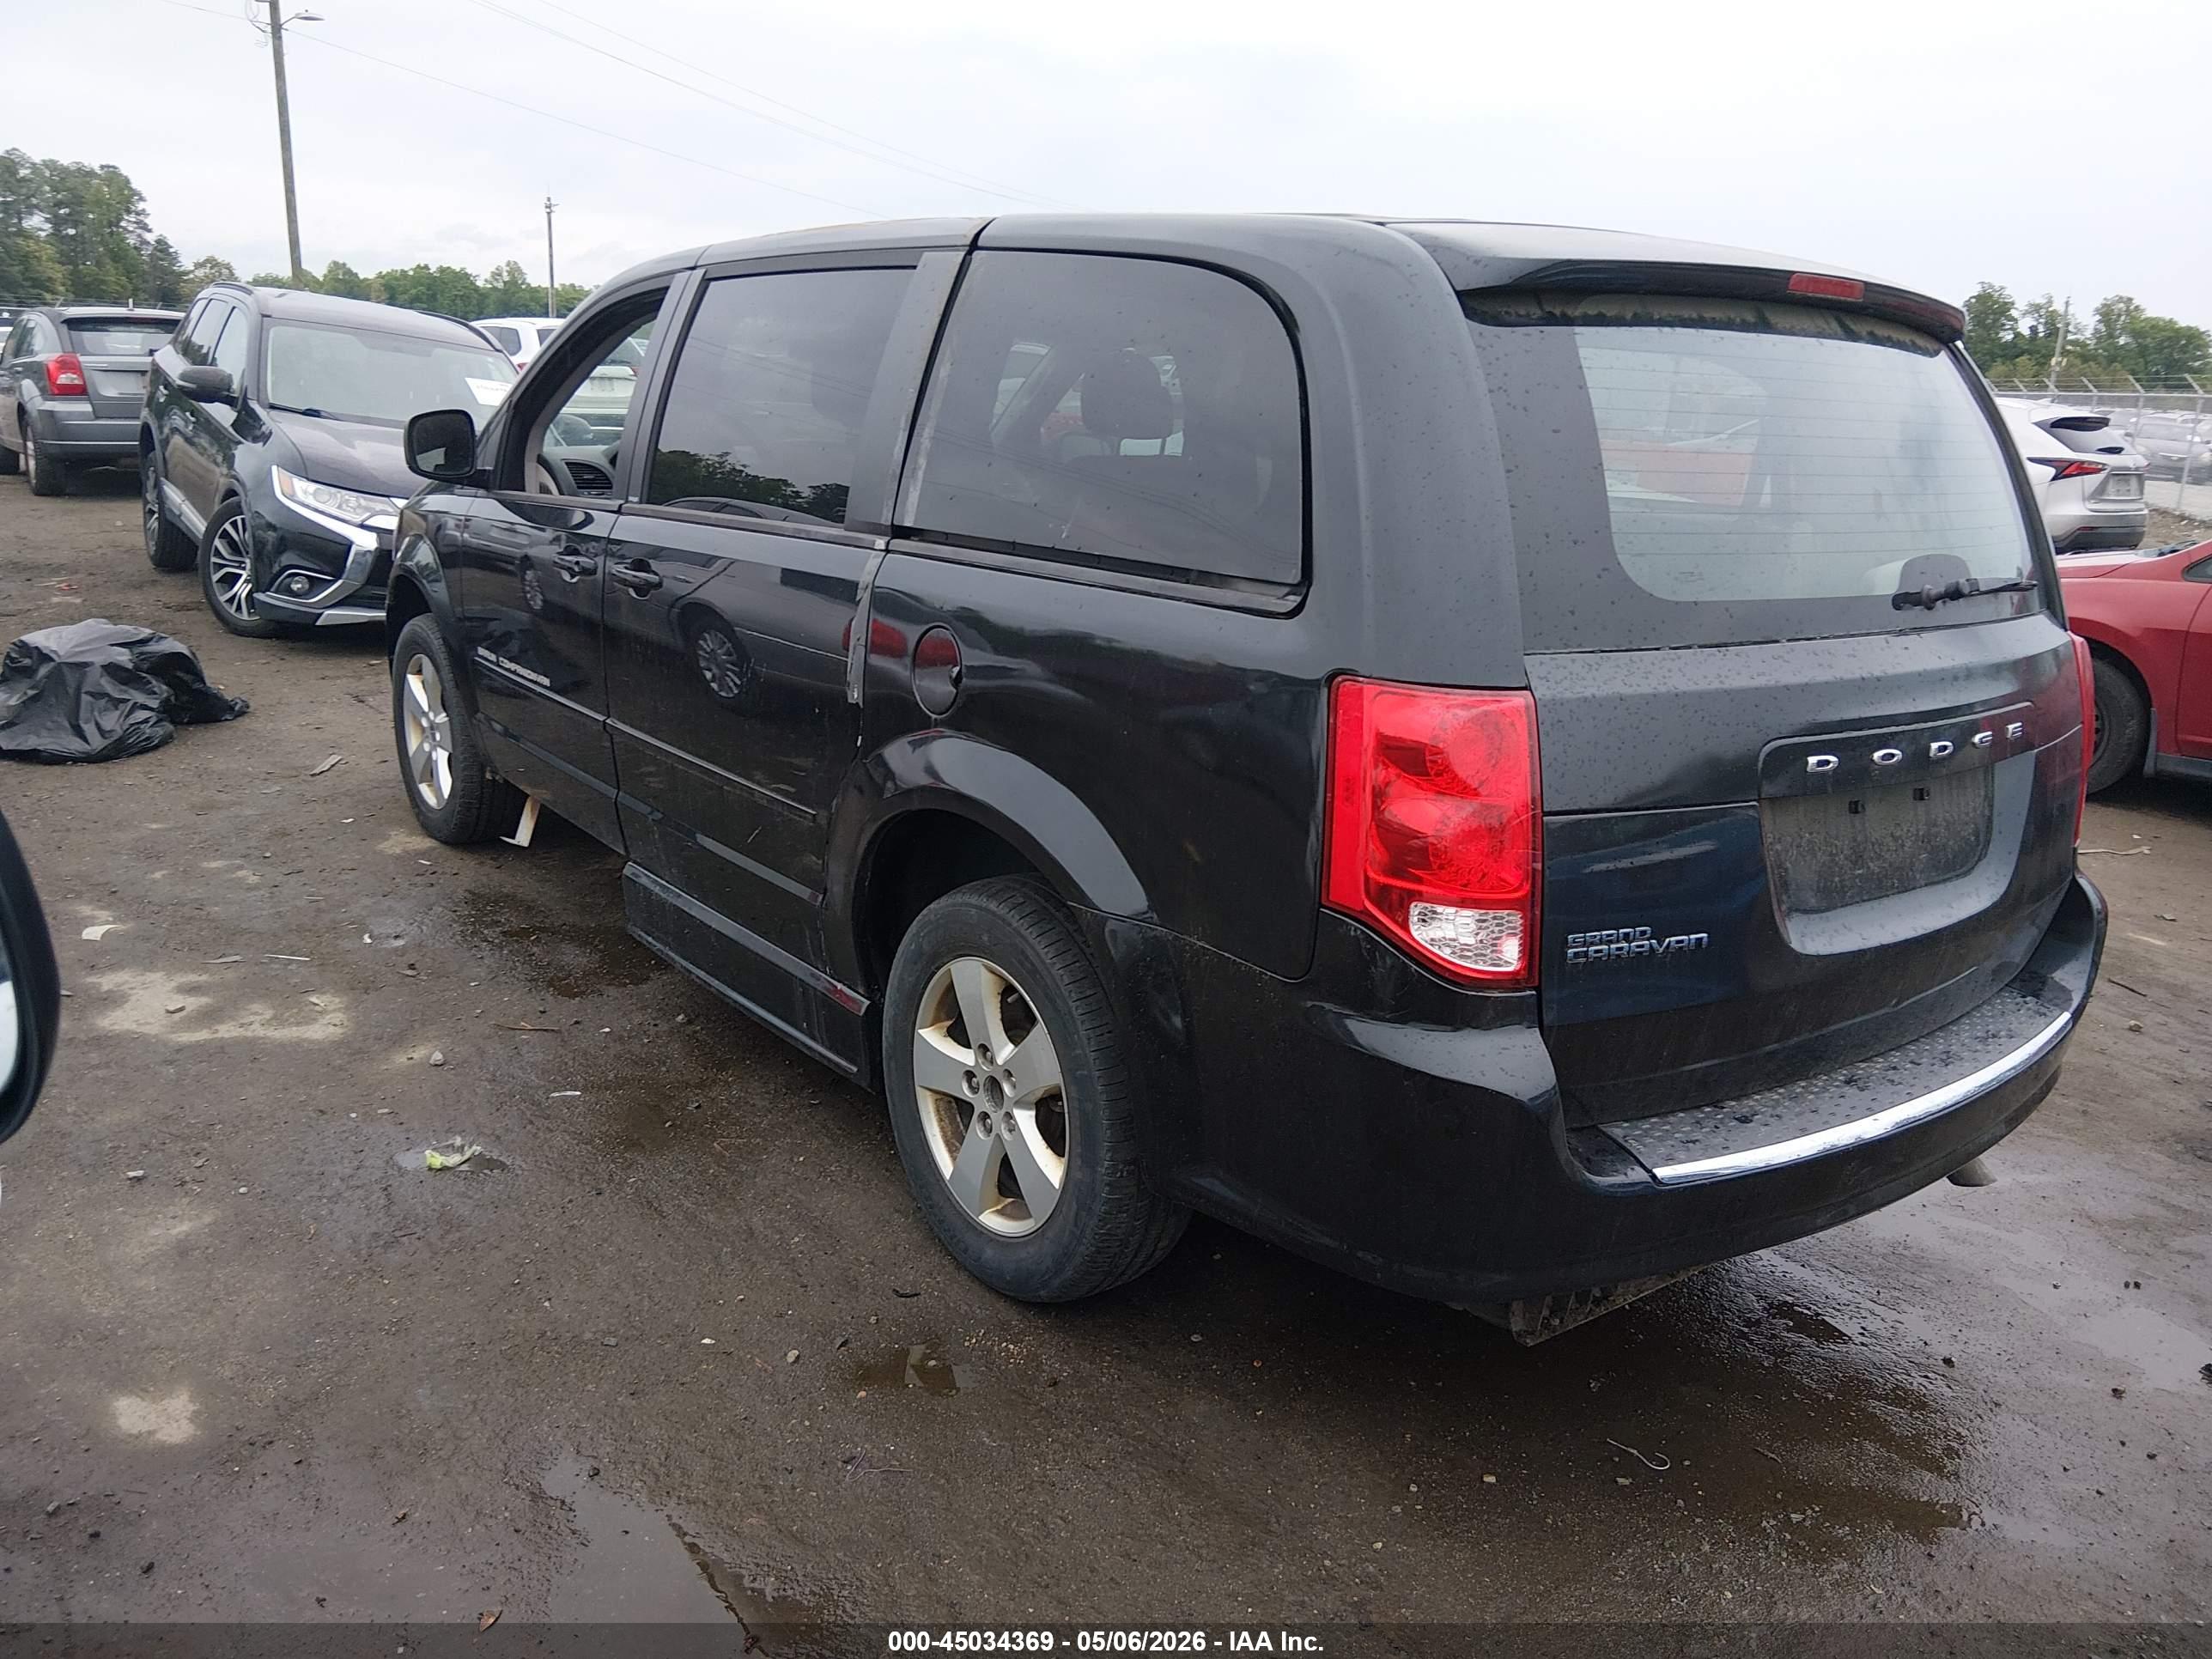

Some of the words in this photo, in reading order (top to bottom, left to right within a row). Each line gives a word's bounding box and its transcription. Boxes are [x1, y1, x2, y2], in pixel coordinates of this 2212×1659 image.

[1806, 721, 2023, 773] DODGE
[1566, 933, 1709, 963] CARAVAN
[1567, 927, 1652, 946] GRAND
